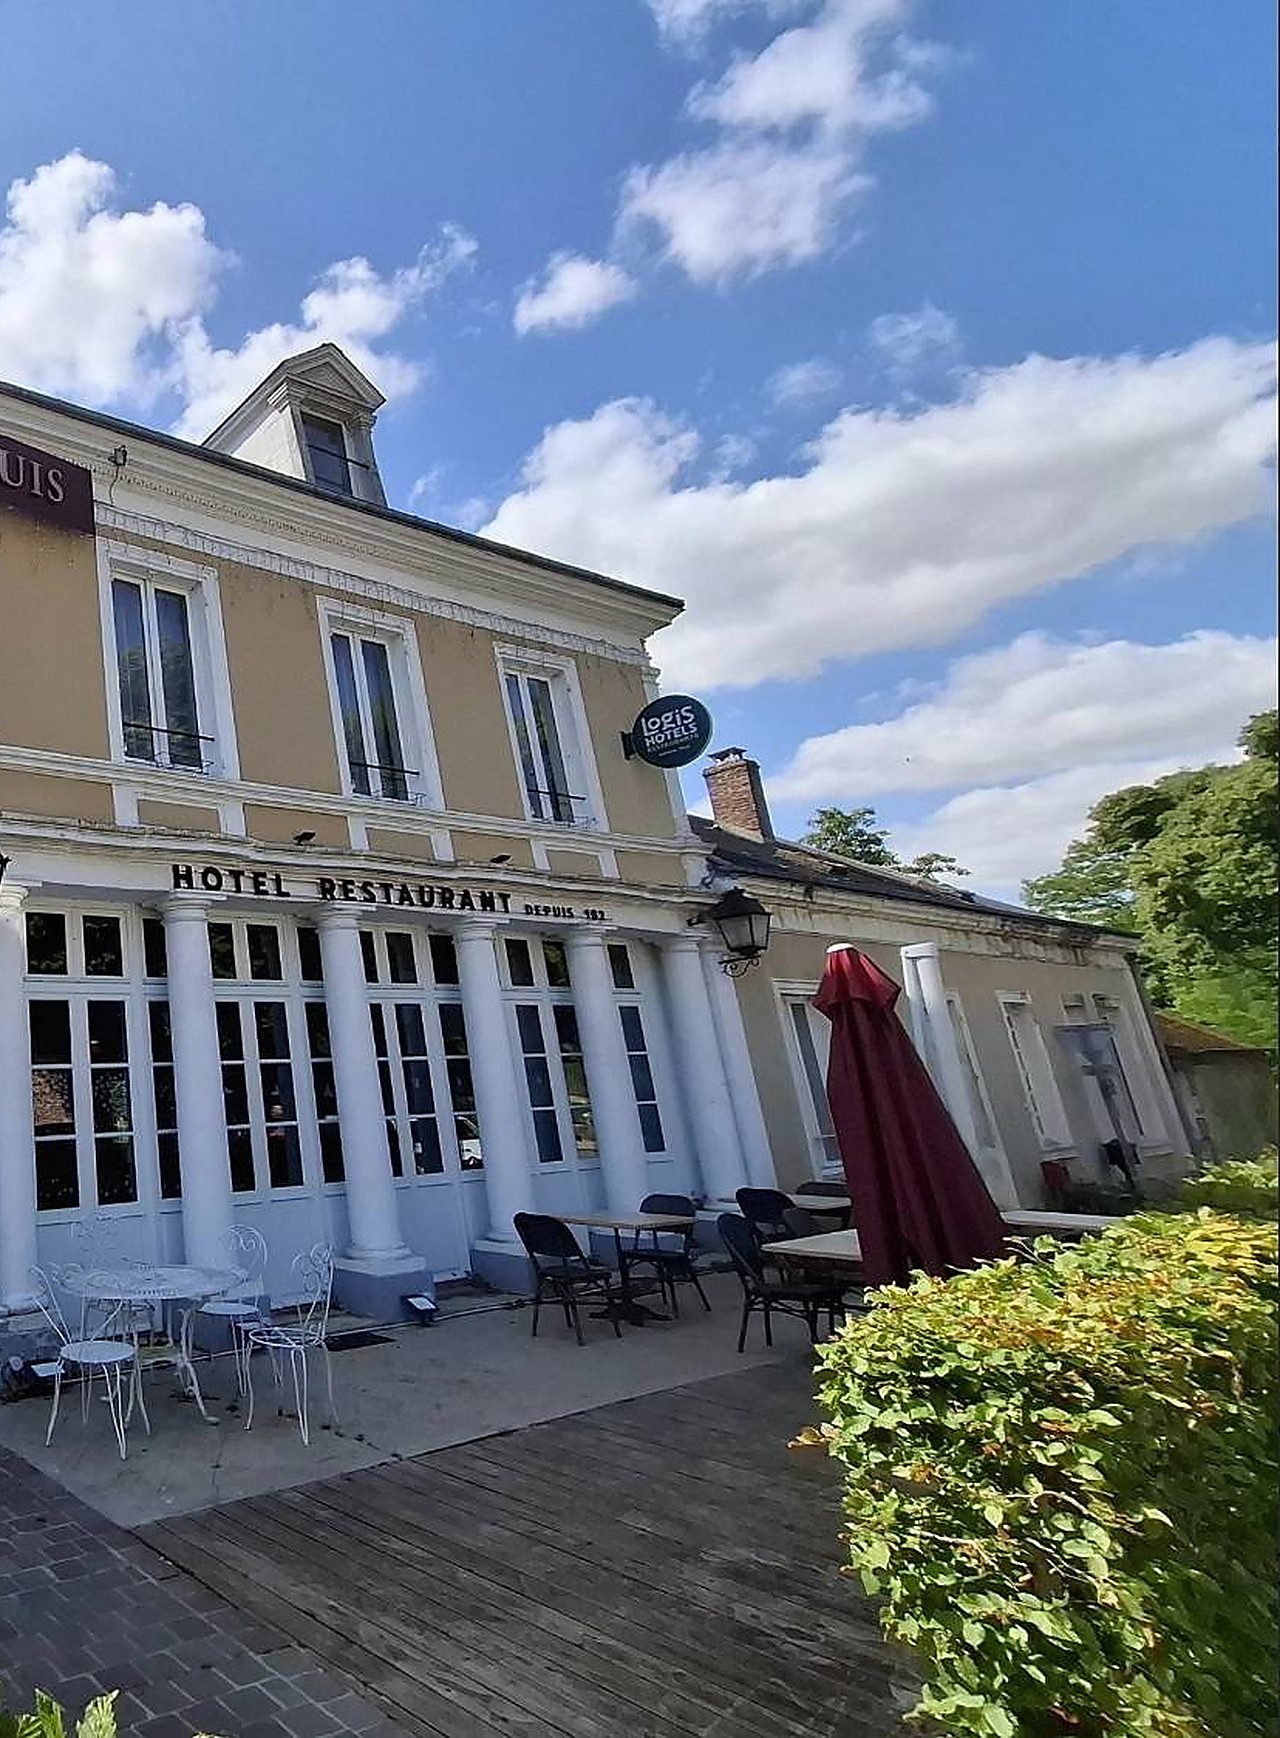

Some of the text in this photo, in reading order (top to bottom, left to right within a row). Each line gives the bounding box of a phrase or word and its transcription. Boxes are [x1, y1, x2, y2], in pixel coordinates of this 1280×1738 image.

[644, 723, 699, 747] HOTELS
[172, 864, 291, 897] HOTEL
[317, 877, 511, 914] RESTAURANT
[524, 903, 575, 918] DEPUIS
